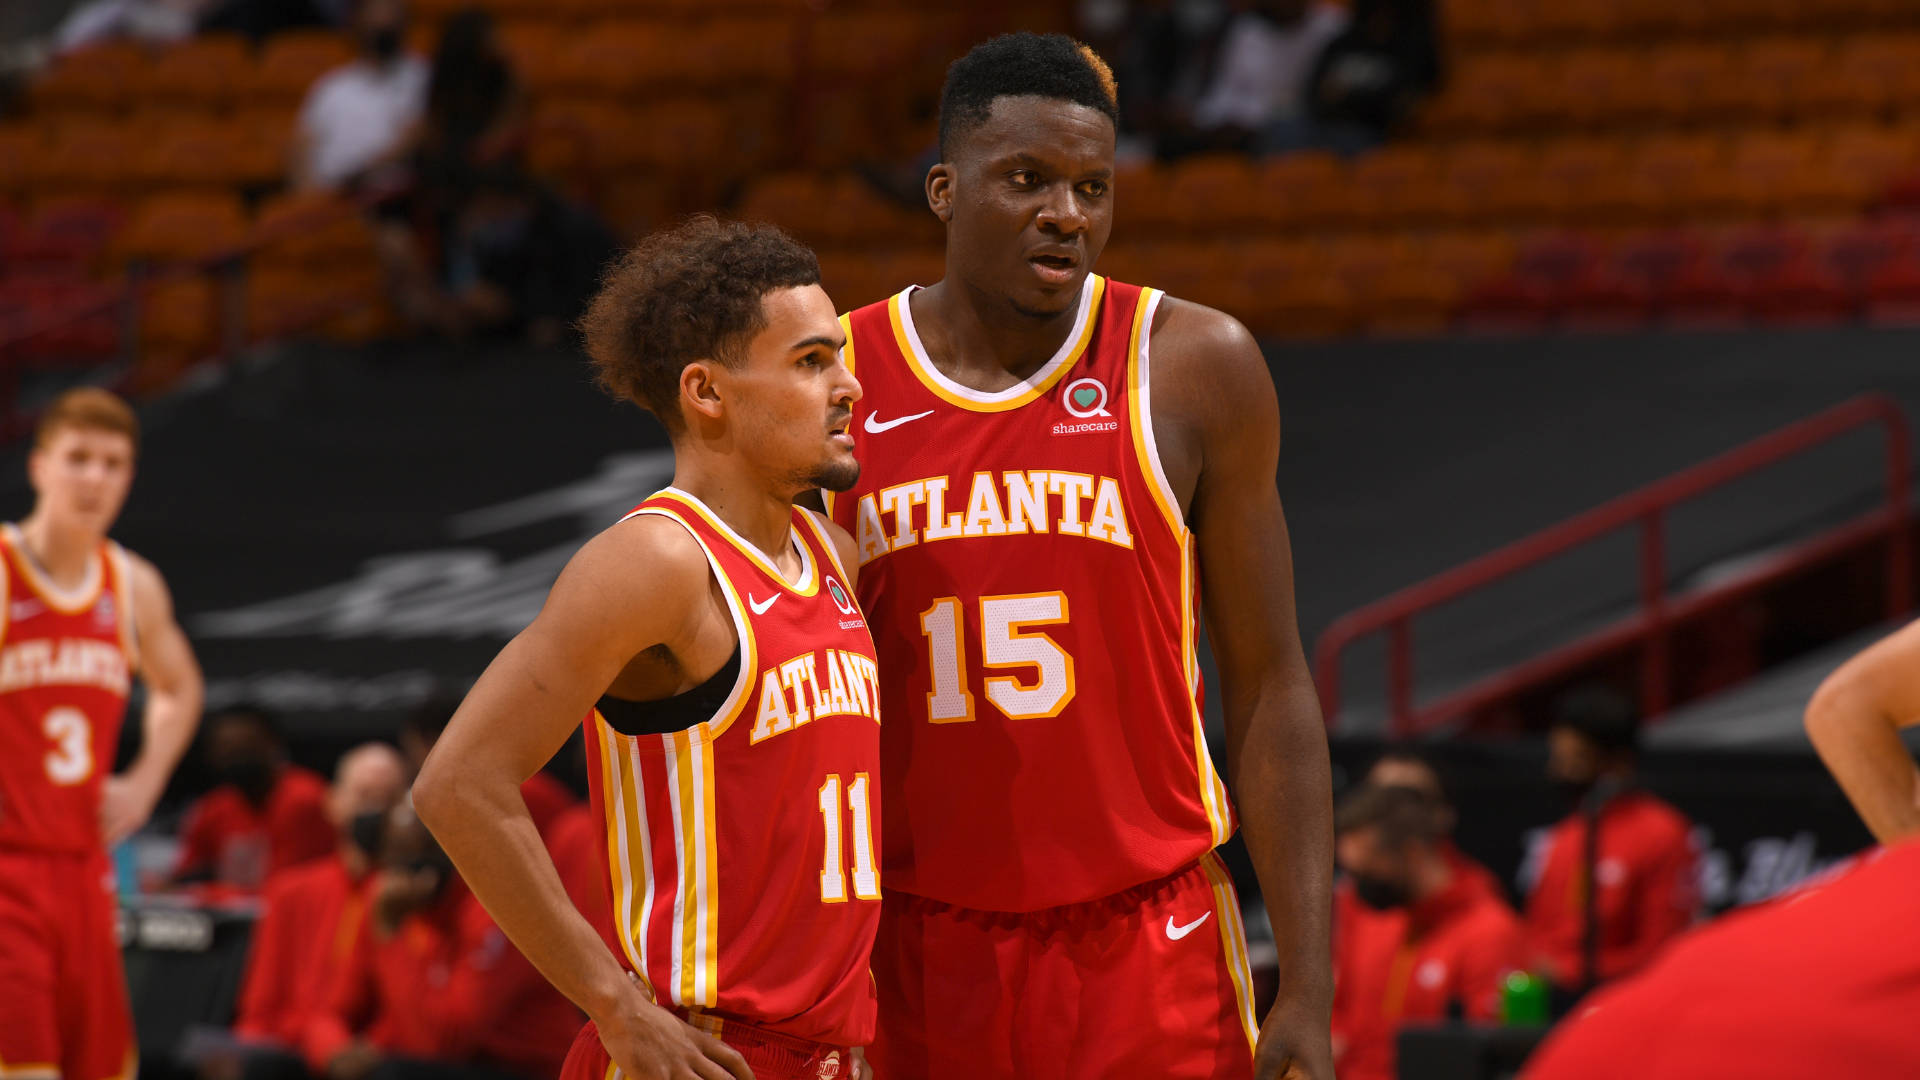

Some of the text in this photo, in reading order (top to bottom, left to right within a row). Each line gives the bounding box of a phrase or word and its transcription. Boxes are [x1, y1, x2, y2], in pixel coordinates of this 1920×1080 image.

[1053, 421, 1118, 434] sharecare
[856, 469, 1134, 568] ATLANTA
[919, 590, 1076, 724] 15
[41, 705, 96, 787] 3
[818, 771, 883, 903] 11
